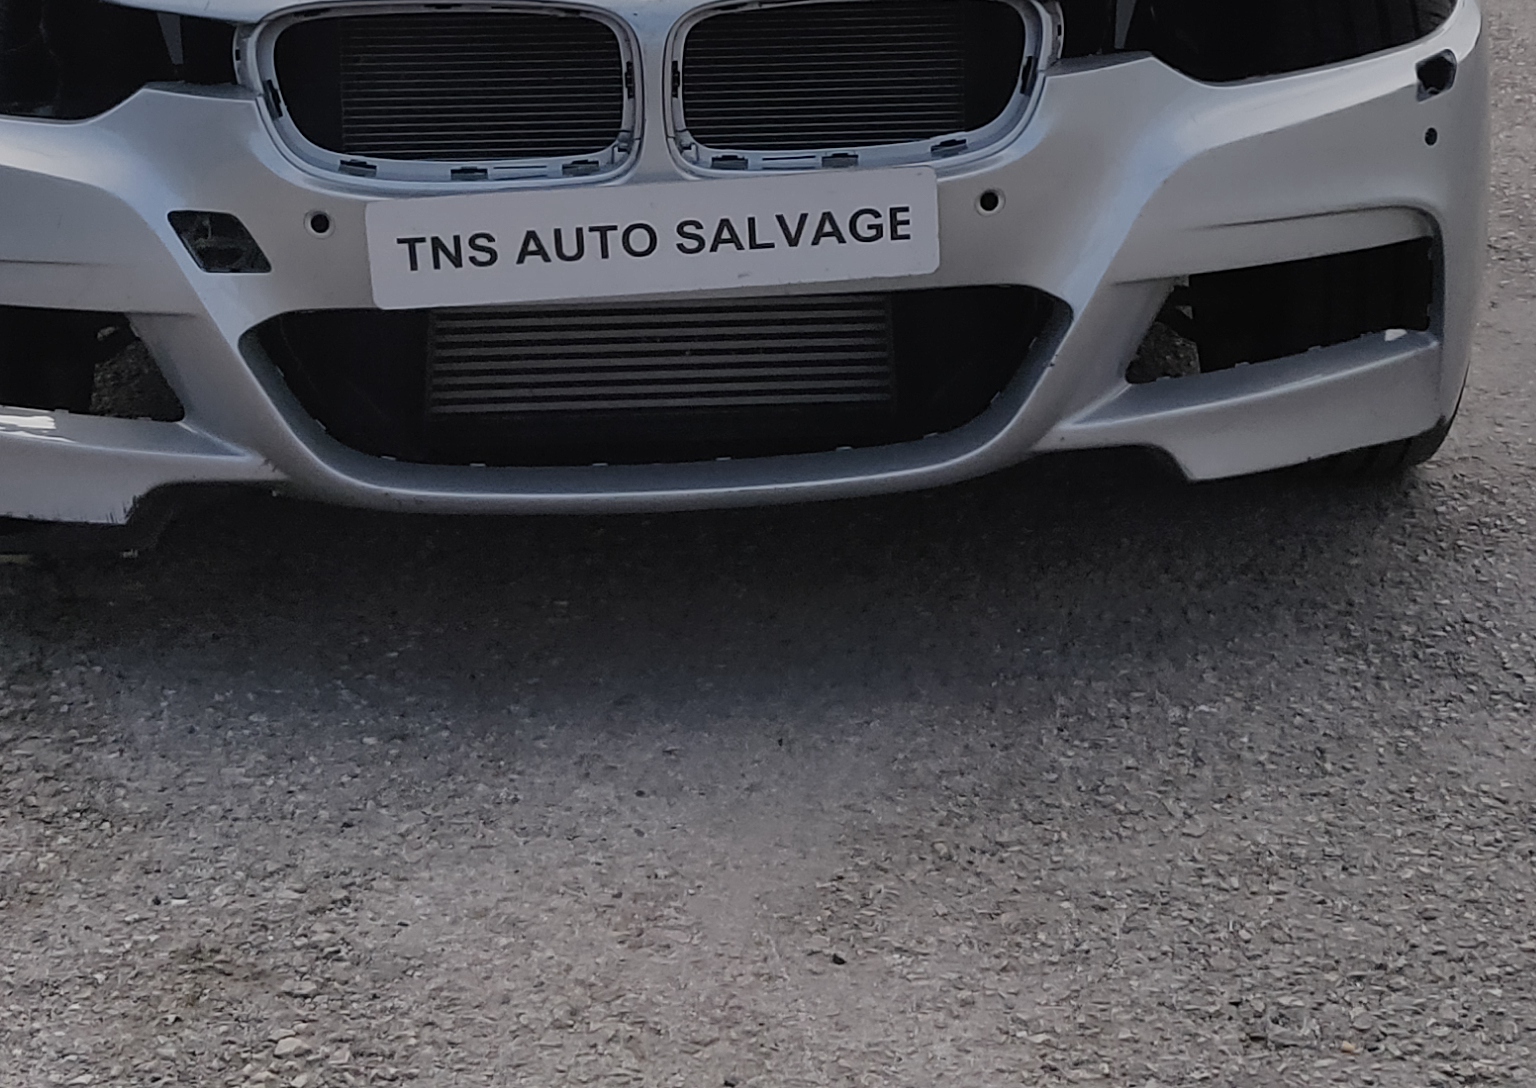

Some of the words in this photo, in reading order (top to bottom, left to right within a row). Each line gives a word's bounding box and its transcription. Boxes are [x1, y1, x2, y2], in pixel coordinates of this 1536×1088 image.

[396, 232, 498, 272] TNS
[516, 223, 658, 265] AUTO
[675, 206, 912, 254] SALVAGE
